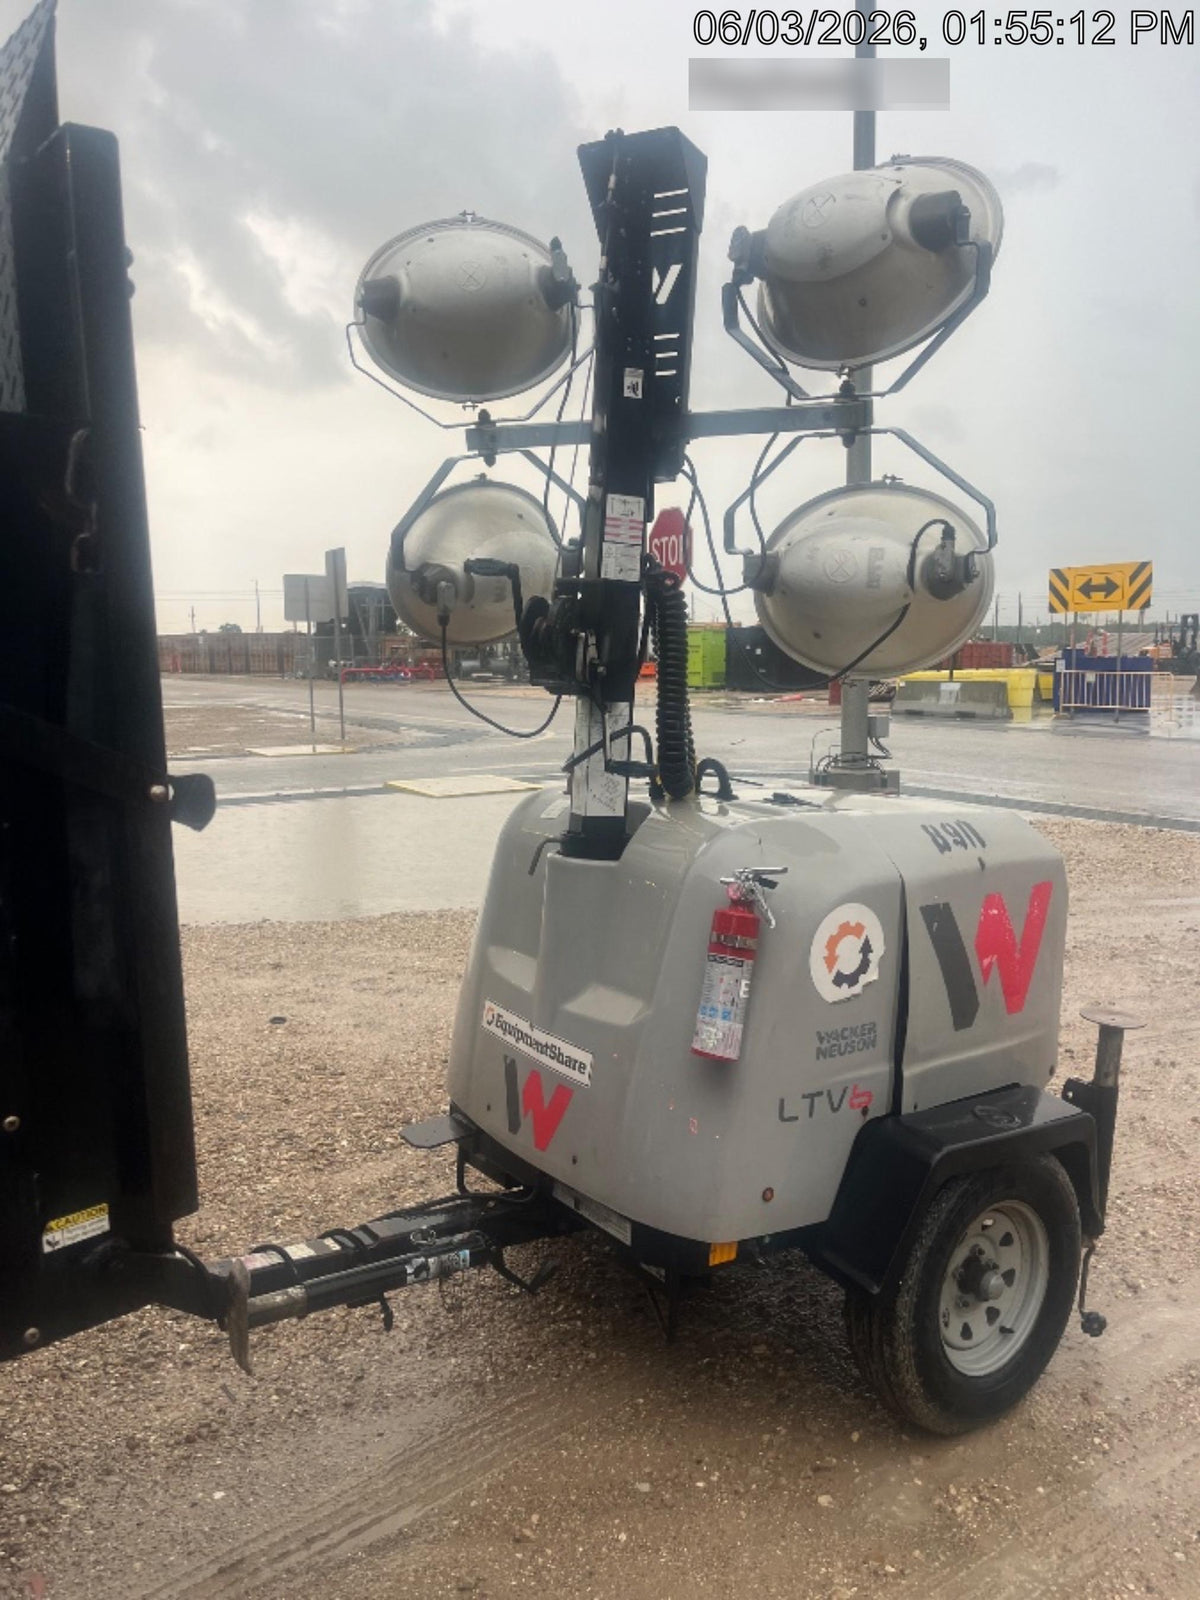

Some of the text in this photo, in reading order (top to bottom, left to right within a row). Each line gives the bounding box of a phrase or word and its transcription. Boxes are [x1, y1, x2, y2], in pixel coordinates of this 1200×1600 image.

[494, 1013, 588, 1076] EquipmentShare
[816, 1021, 877, 1045] WACKER
[816, 1039, 877, 1061] NEUSON
[779, 1083, 874, 1122] LTV6
[56, 1206, 105, 1228] CAUTION
